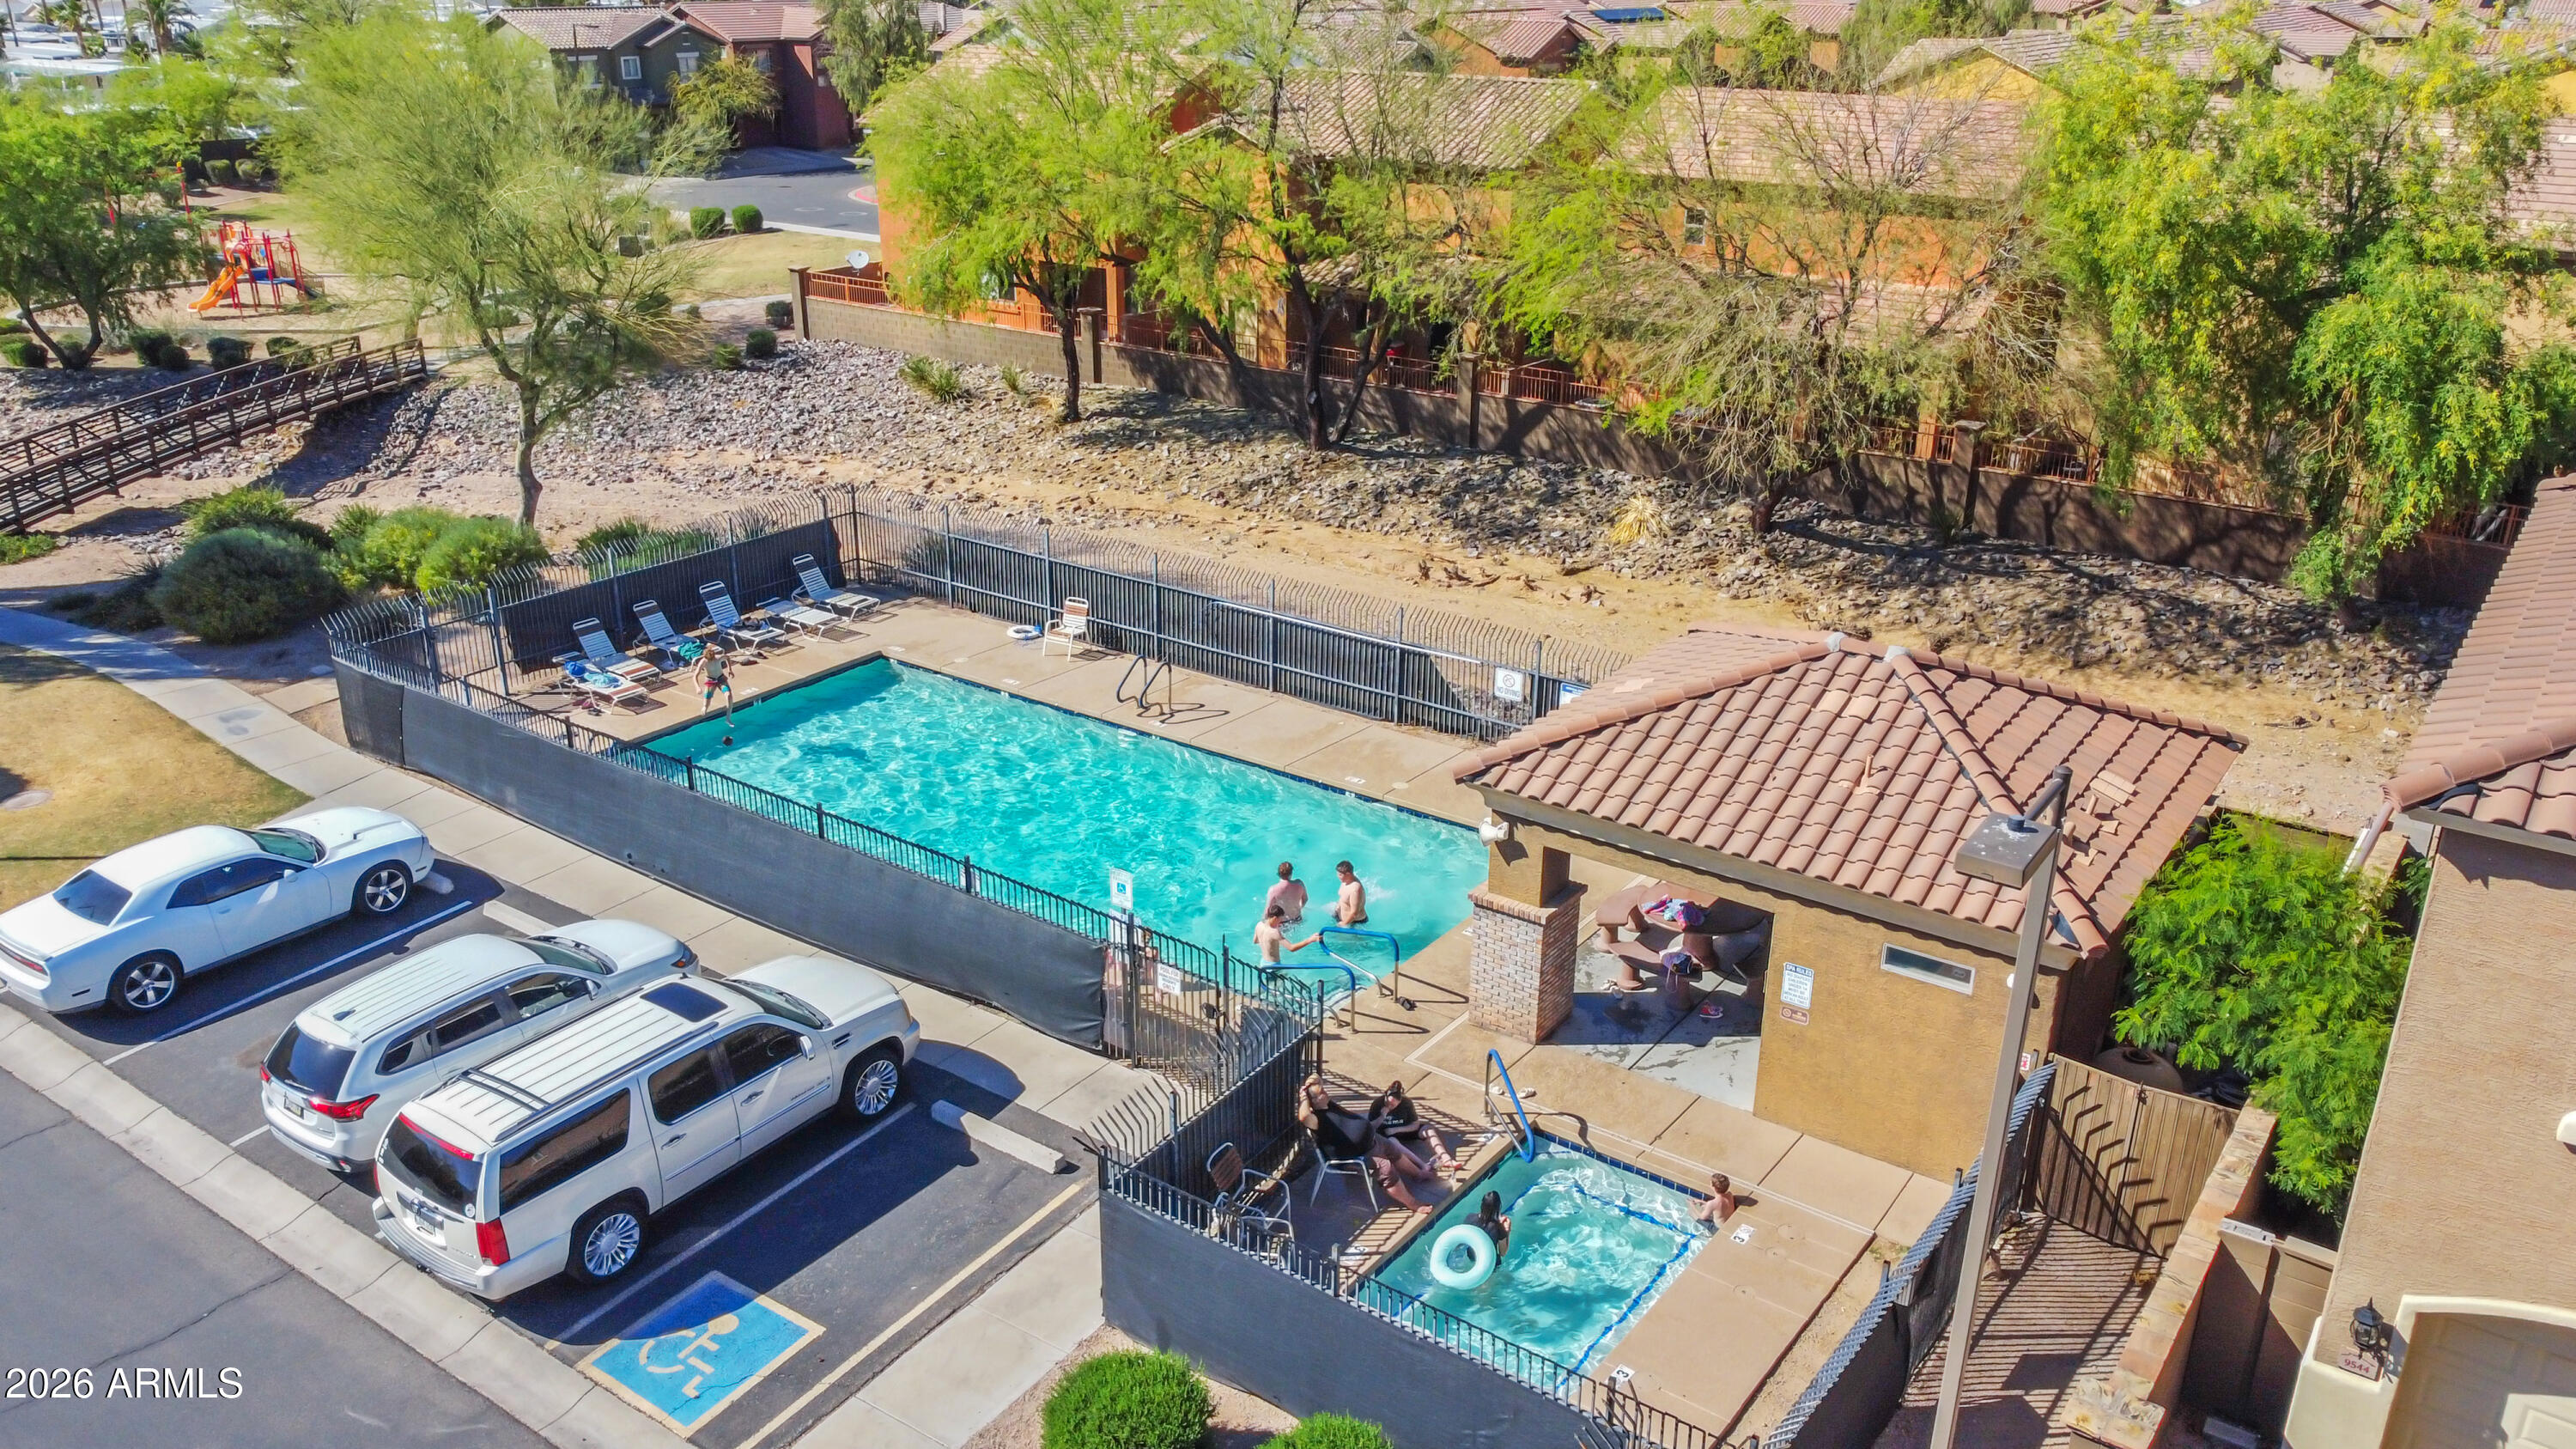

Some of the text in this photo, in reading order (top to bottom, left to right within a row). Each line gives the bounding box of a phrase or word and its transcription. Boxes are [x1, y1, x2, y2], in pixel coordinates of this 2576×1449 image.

[1504, 687, 1520, 698] DIVING
[1796, 967, 1811, 976] RULES
[2344, 1359, 2370, 1373] 9544
[1616, 1369, 1629, 1378] 3
